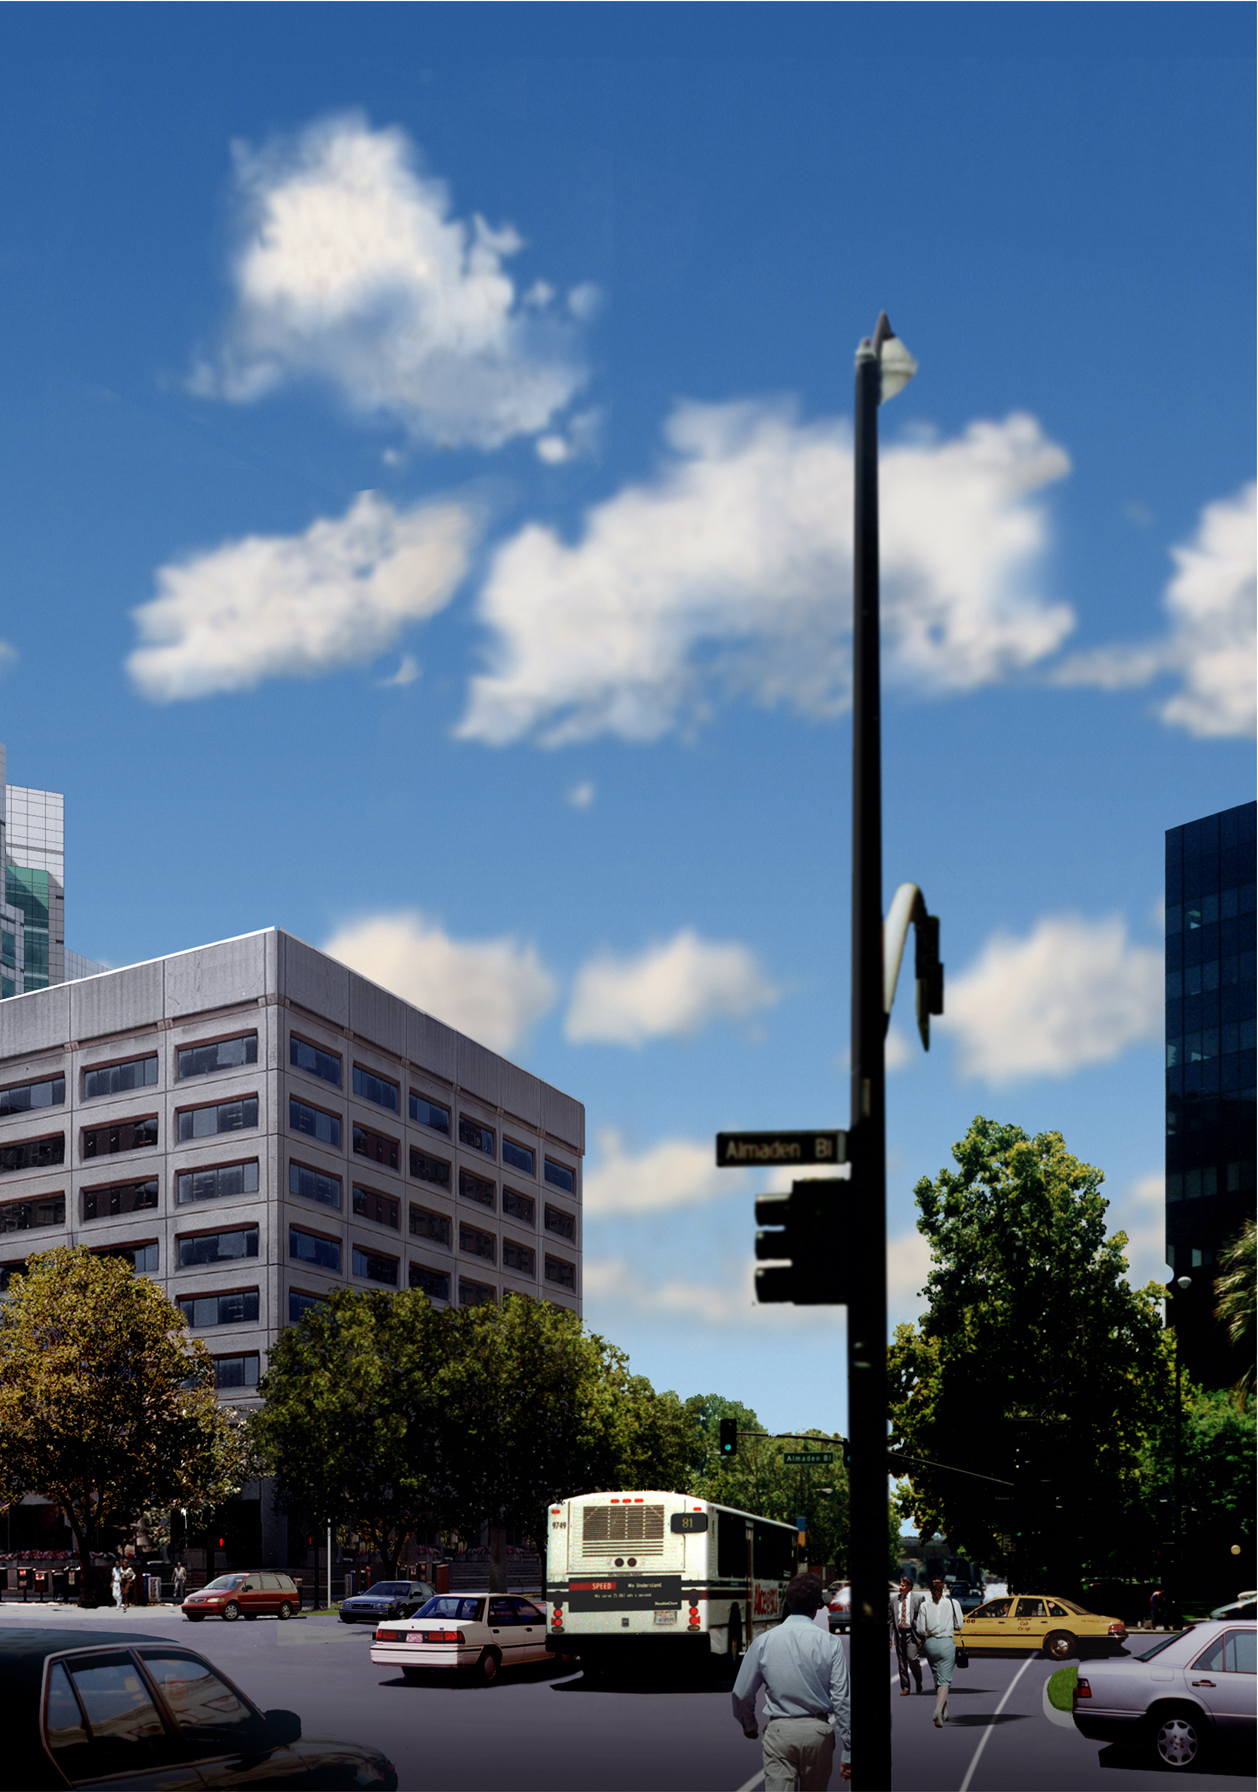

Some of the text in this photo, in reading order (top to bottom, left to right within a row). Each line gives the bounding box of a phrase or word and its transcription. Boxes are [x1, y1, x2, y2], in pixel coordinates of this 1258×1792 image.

[725, 1139, 801, 1160] Almaden
[786, 1454, 821, 1462] Almaden
[552, 1522, 567, 1530] 9749
[682, 1517, 693, 1528] 81
[592, 1582, 612, 1590] SPEED
